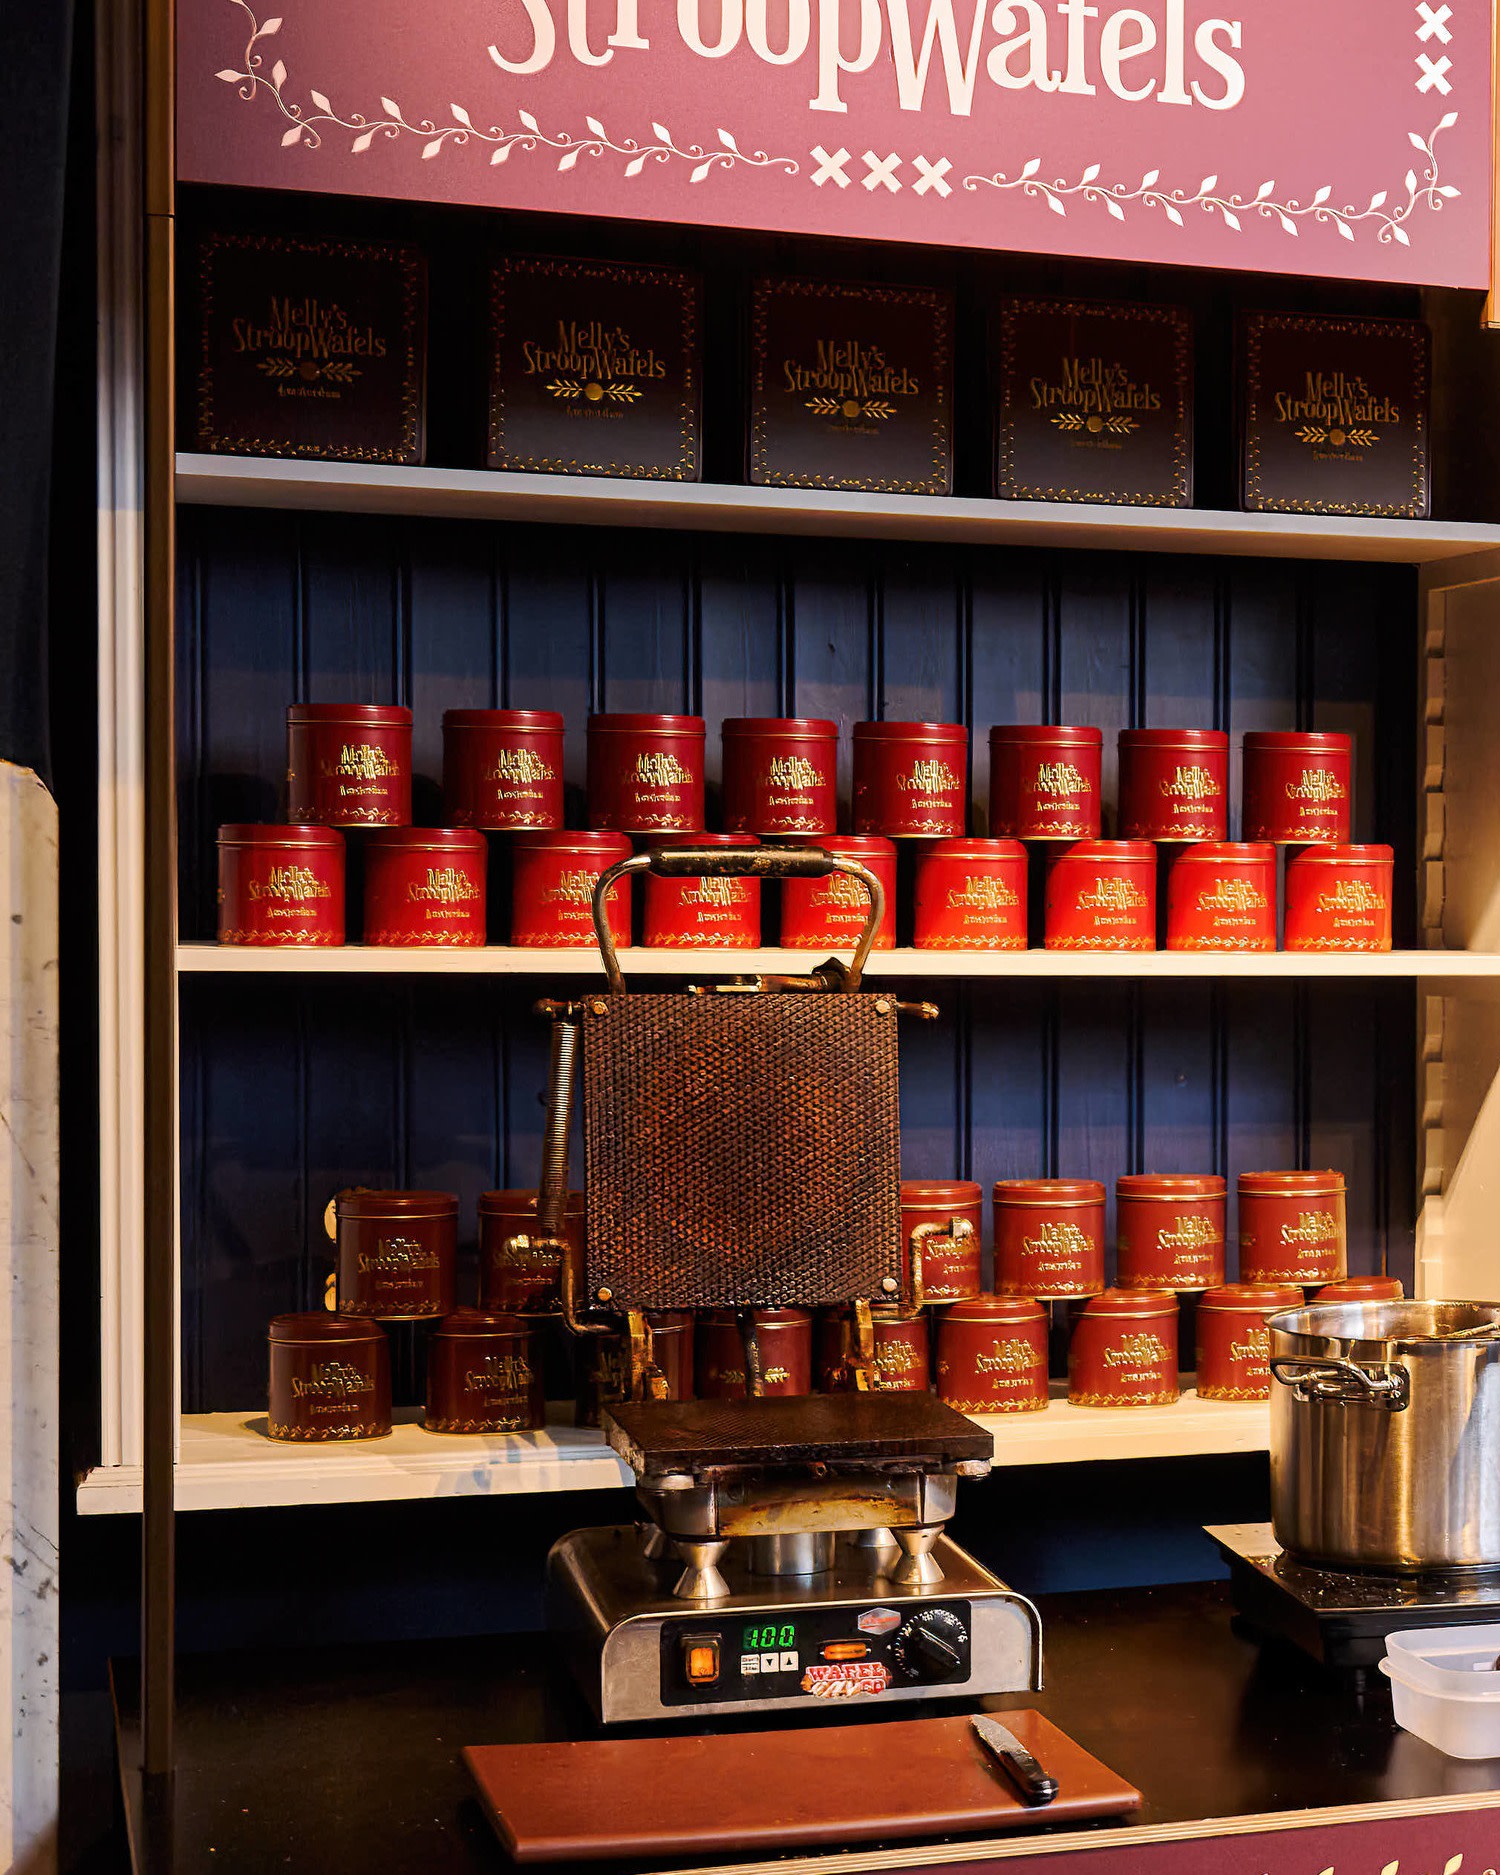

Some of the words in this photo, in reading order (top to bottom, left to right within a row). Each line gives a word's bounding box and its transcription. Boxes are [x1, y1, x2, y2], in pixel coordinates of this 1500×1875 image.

[271, 296, 348, 332] Melly's
[558, 320, 631, 353] Melly's
[817, 339, 886, 371] Melly's
[1063, 356, 1128, 387] Melly's
[1306, 371, 1368, 403] Melly's
[750, 1625, 795, 1649] 100
